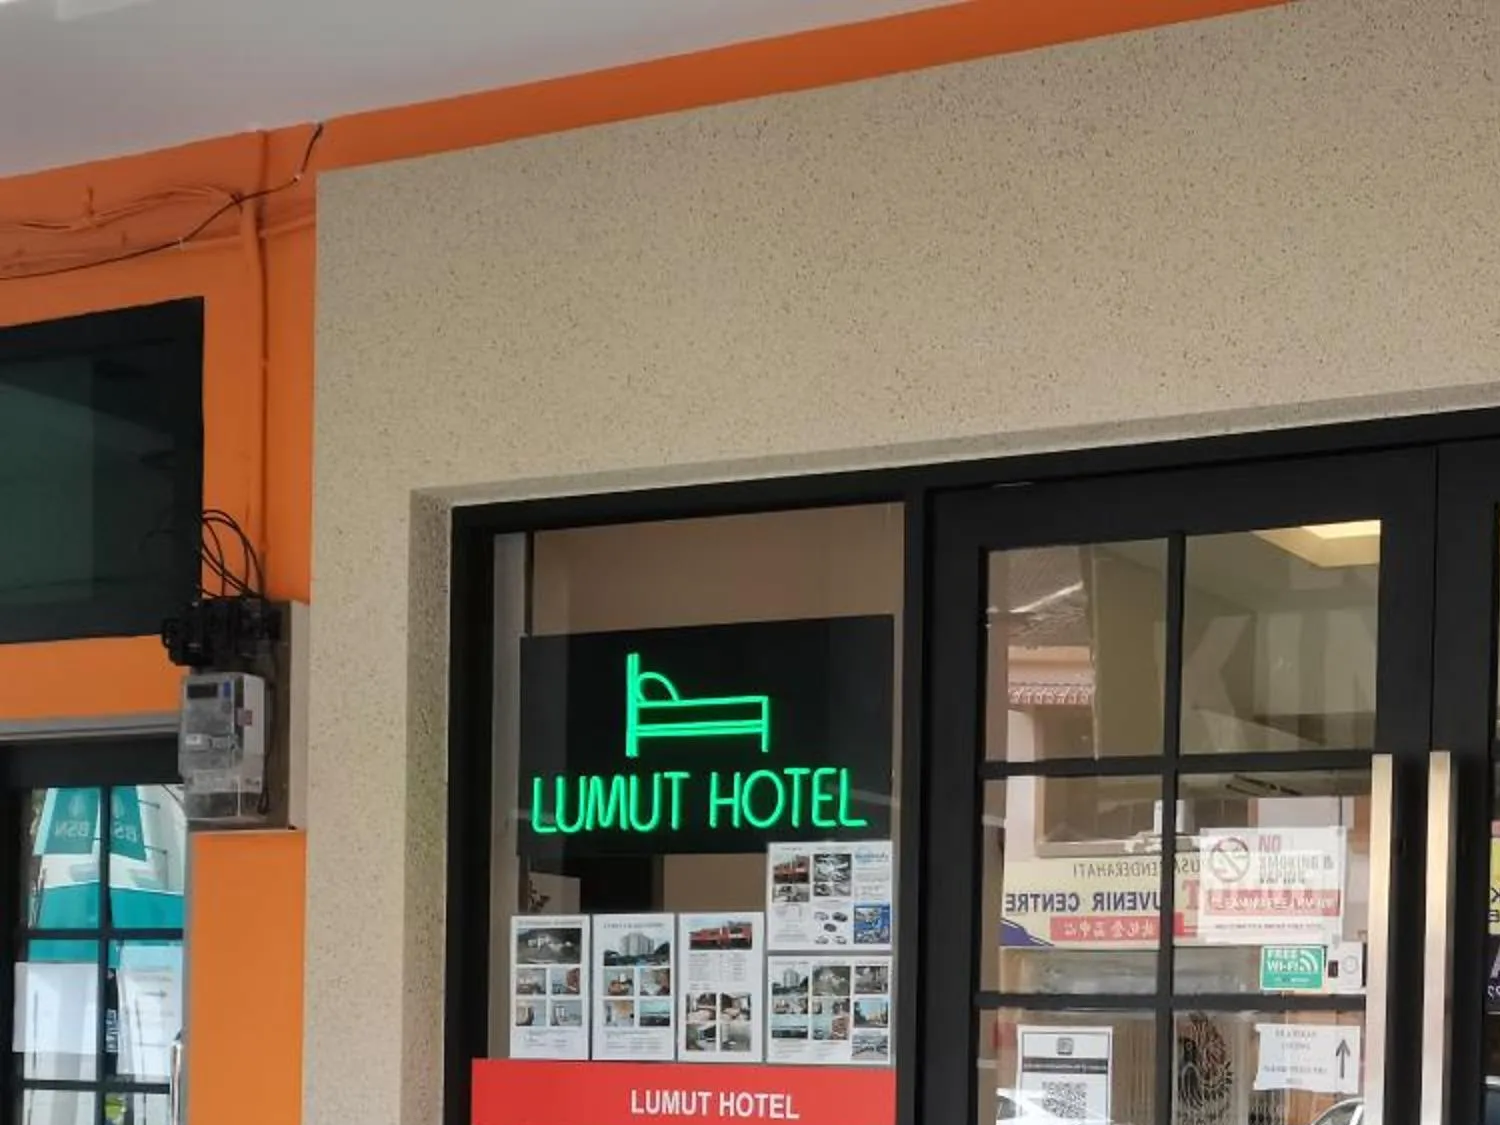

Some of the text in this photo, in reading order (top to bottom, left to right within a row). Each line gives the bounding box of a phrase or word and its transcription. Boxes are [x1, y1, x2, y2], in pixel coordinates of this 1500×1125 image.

[531, 767, 868, 833] LUMUT HOTEL
[1258, 834, 1282, 853] NO
[1266, 948, 1299, 960] FREE
[630, 1088, 800, 1121] LUMUT HOTEL
